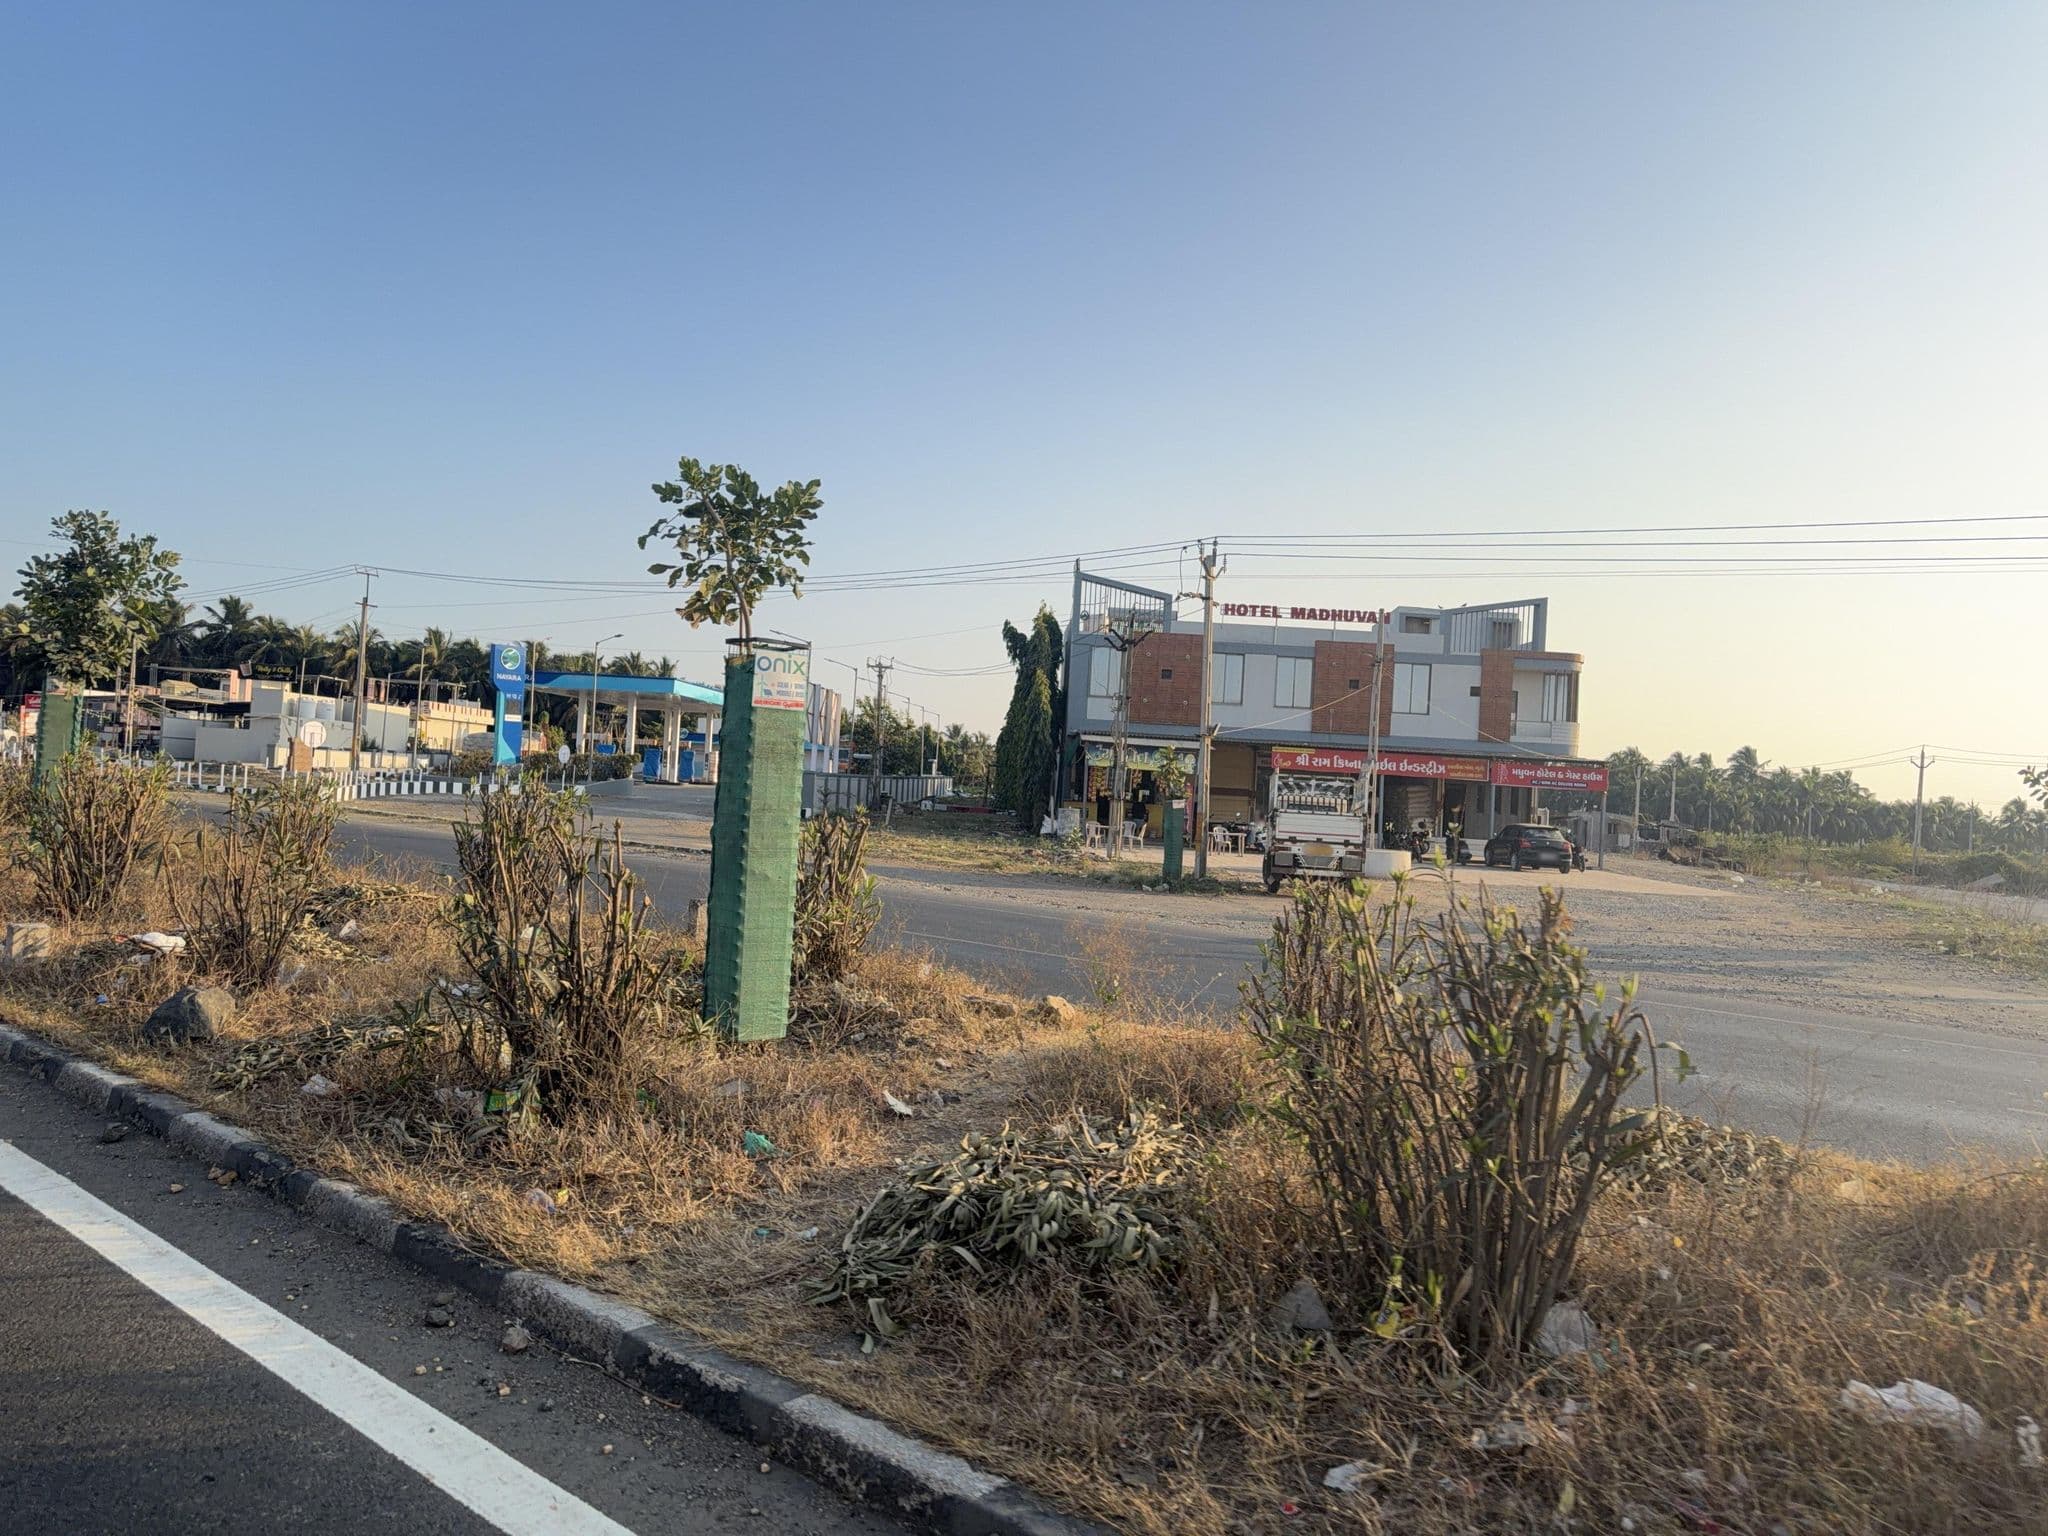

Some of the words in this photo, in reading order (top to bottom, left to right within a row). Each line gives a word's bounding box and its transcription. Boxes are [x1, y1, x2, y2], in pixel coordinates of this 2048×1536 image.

[1223, 603, 1282, 618] HOTEL
[757, 654, 806, 676] onix
[496, 673, 522, 682] NAYARA
[1295, 753, 1309, 767] શ્રી
[1311, 757, 1331, 768] રામ
[1511, 767, 1535, 780] મધુવન
[1566, 769, 1582, 781] ગેસ્ટ
